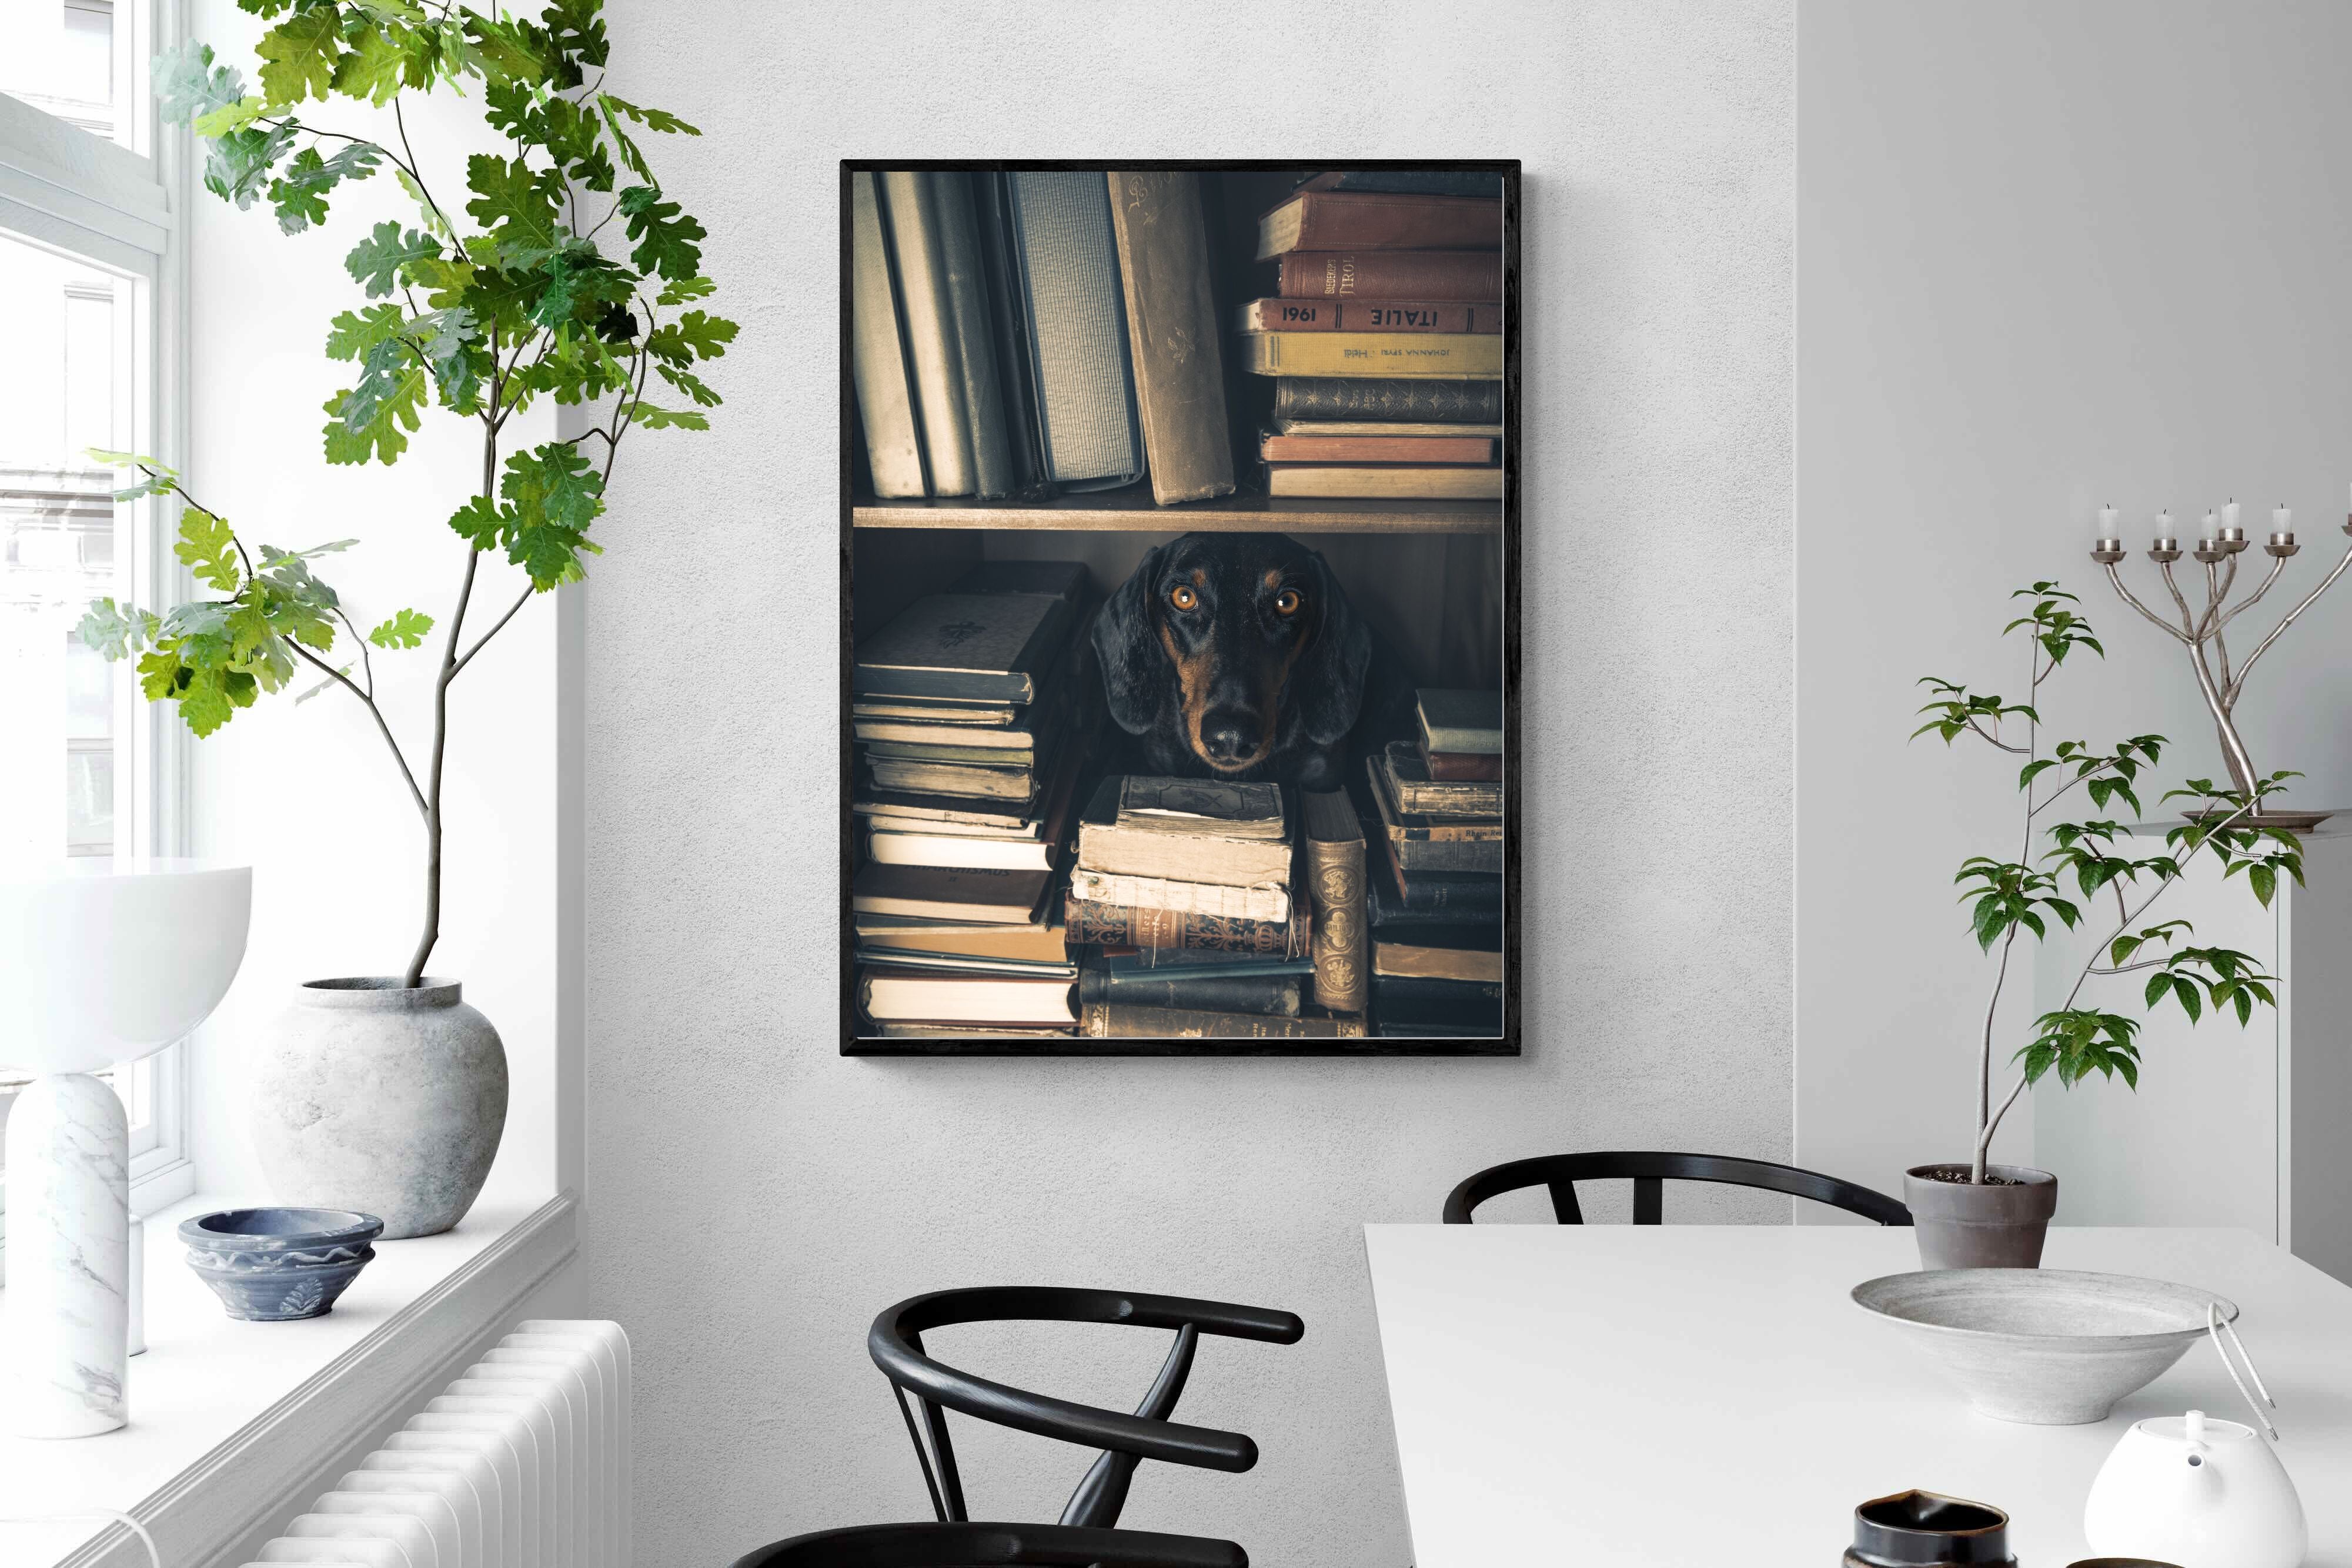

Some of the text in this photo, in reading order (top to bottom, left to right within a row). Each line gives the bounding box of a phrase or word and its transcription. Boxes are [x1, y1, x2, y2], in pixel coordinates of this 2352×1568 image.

[1324, 259, 1337, 294] BAEDEKERS
[1339, 256, 1355, 297] TIROL
[1282, 307, 1438, 327] ITALIE 1961
[1344, 348, 1449, 358] JOHANNA SPYRI Heidi
